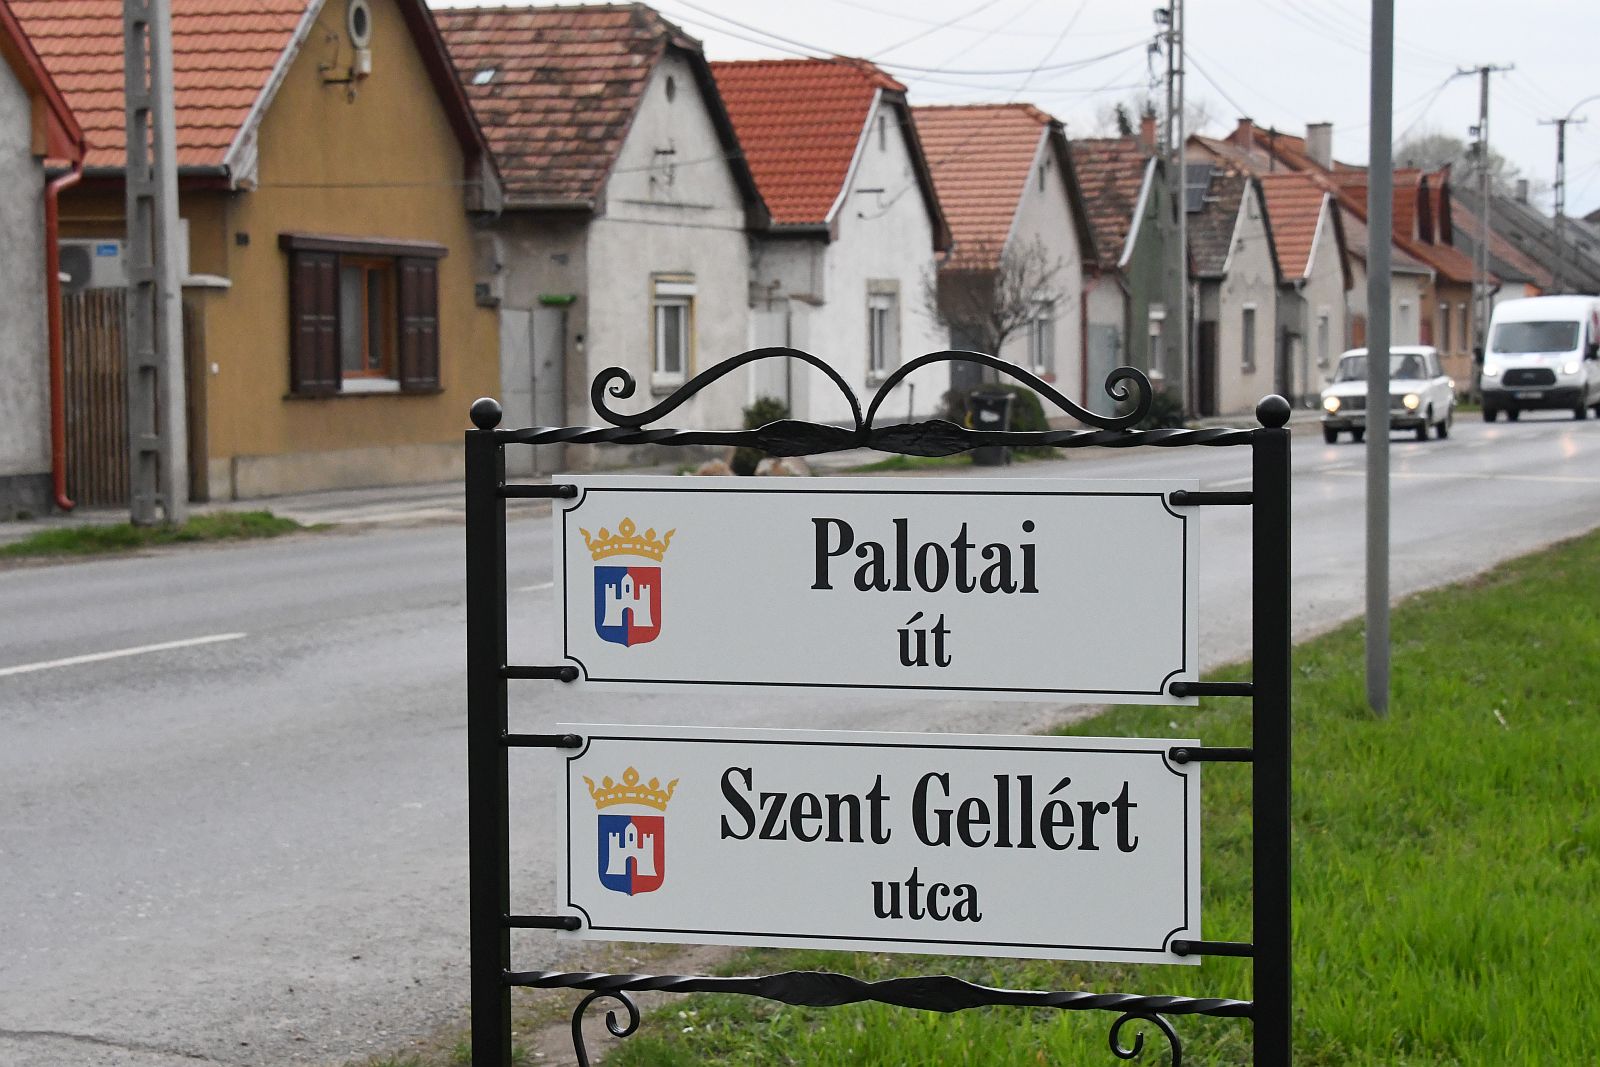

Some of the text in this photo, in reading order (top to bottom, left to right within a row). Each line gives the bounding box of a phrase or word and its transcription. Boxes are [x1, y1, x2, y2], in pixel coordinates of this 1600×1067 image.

[810, 517, 1040, 595] Palotai
[896, 611, 953, 668] út
[720, 766, 1139, 853] Szent Gellért
[871, 866, 983, 923] utca
